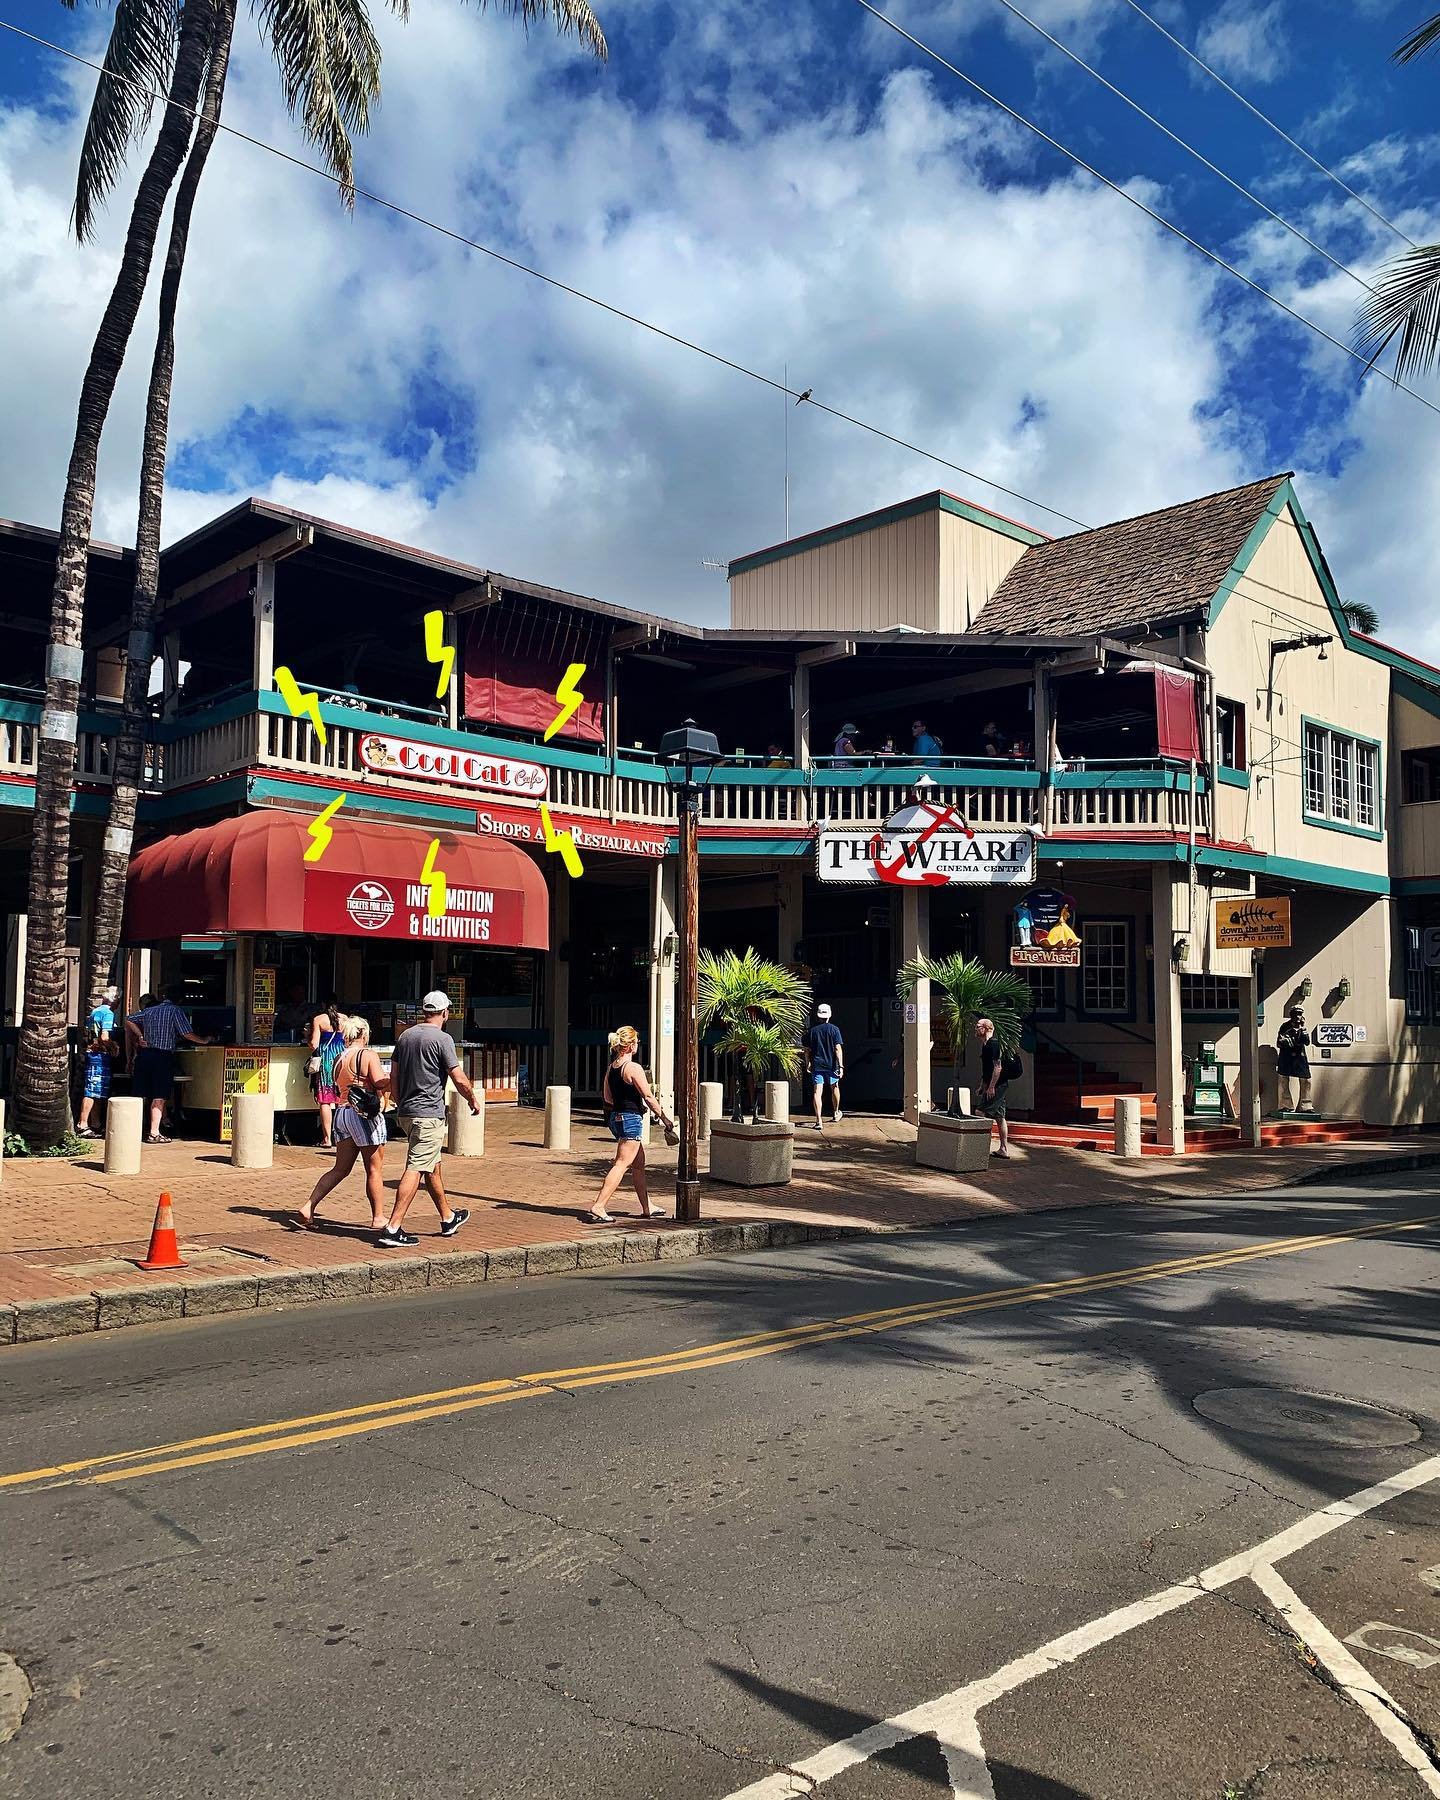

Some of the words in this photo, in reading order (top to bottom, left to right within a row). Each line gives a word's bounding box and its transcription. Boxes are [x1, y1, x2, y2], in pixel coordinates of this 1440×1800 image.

[399, 746, 459, 777] Cool
[465, 759, 511, 786] Cat
[479, 812, 530, 840] SHOPS
[570, 828, 664, 856] RESTAURANTS
[825, 839, 893, 869] THE
[899, 840, 1028, 869] WHARF
[937, 865, 981, 873] CINEMA
[984, 865, 1027, 874] CENTER
[406, 884, 494, 913] INFMATION
[347, 899, 369, 911] TICKETS
[370, 903, 380, 912] FOR
[381, 904, 395, 913] LESS
[409, 913, 420, 936] &
[423, 913, 490, 940] ACTIVITIES
[1220, 926, 1243, 935] down
[1246, 924, 1259, 933] the
[1261, 922, 1284, 933] hatch
[1014, 950, 1041, 962] The
[1040, 950, 1077, 964] Wharf
[225, 1058, 255, 1070] HELICOPTER
[224, 1070, 239, 1081] LUAU
[224, 1082, 245, 1094] ZIPLINE
